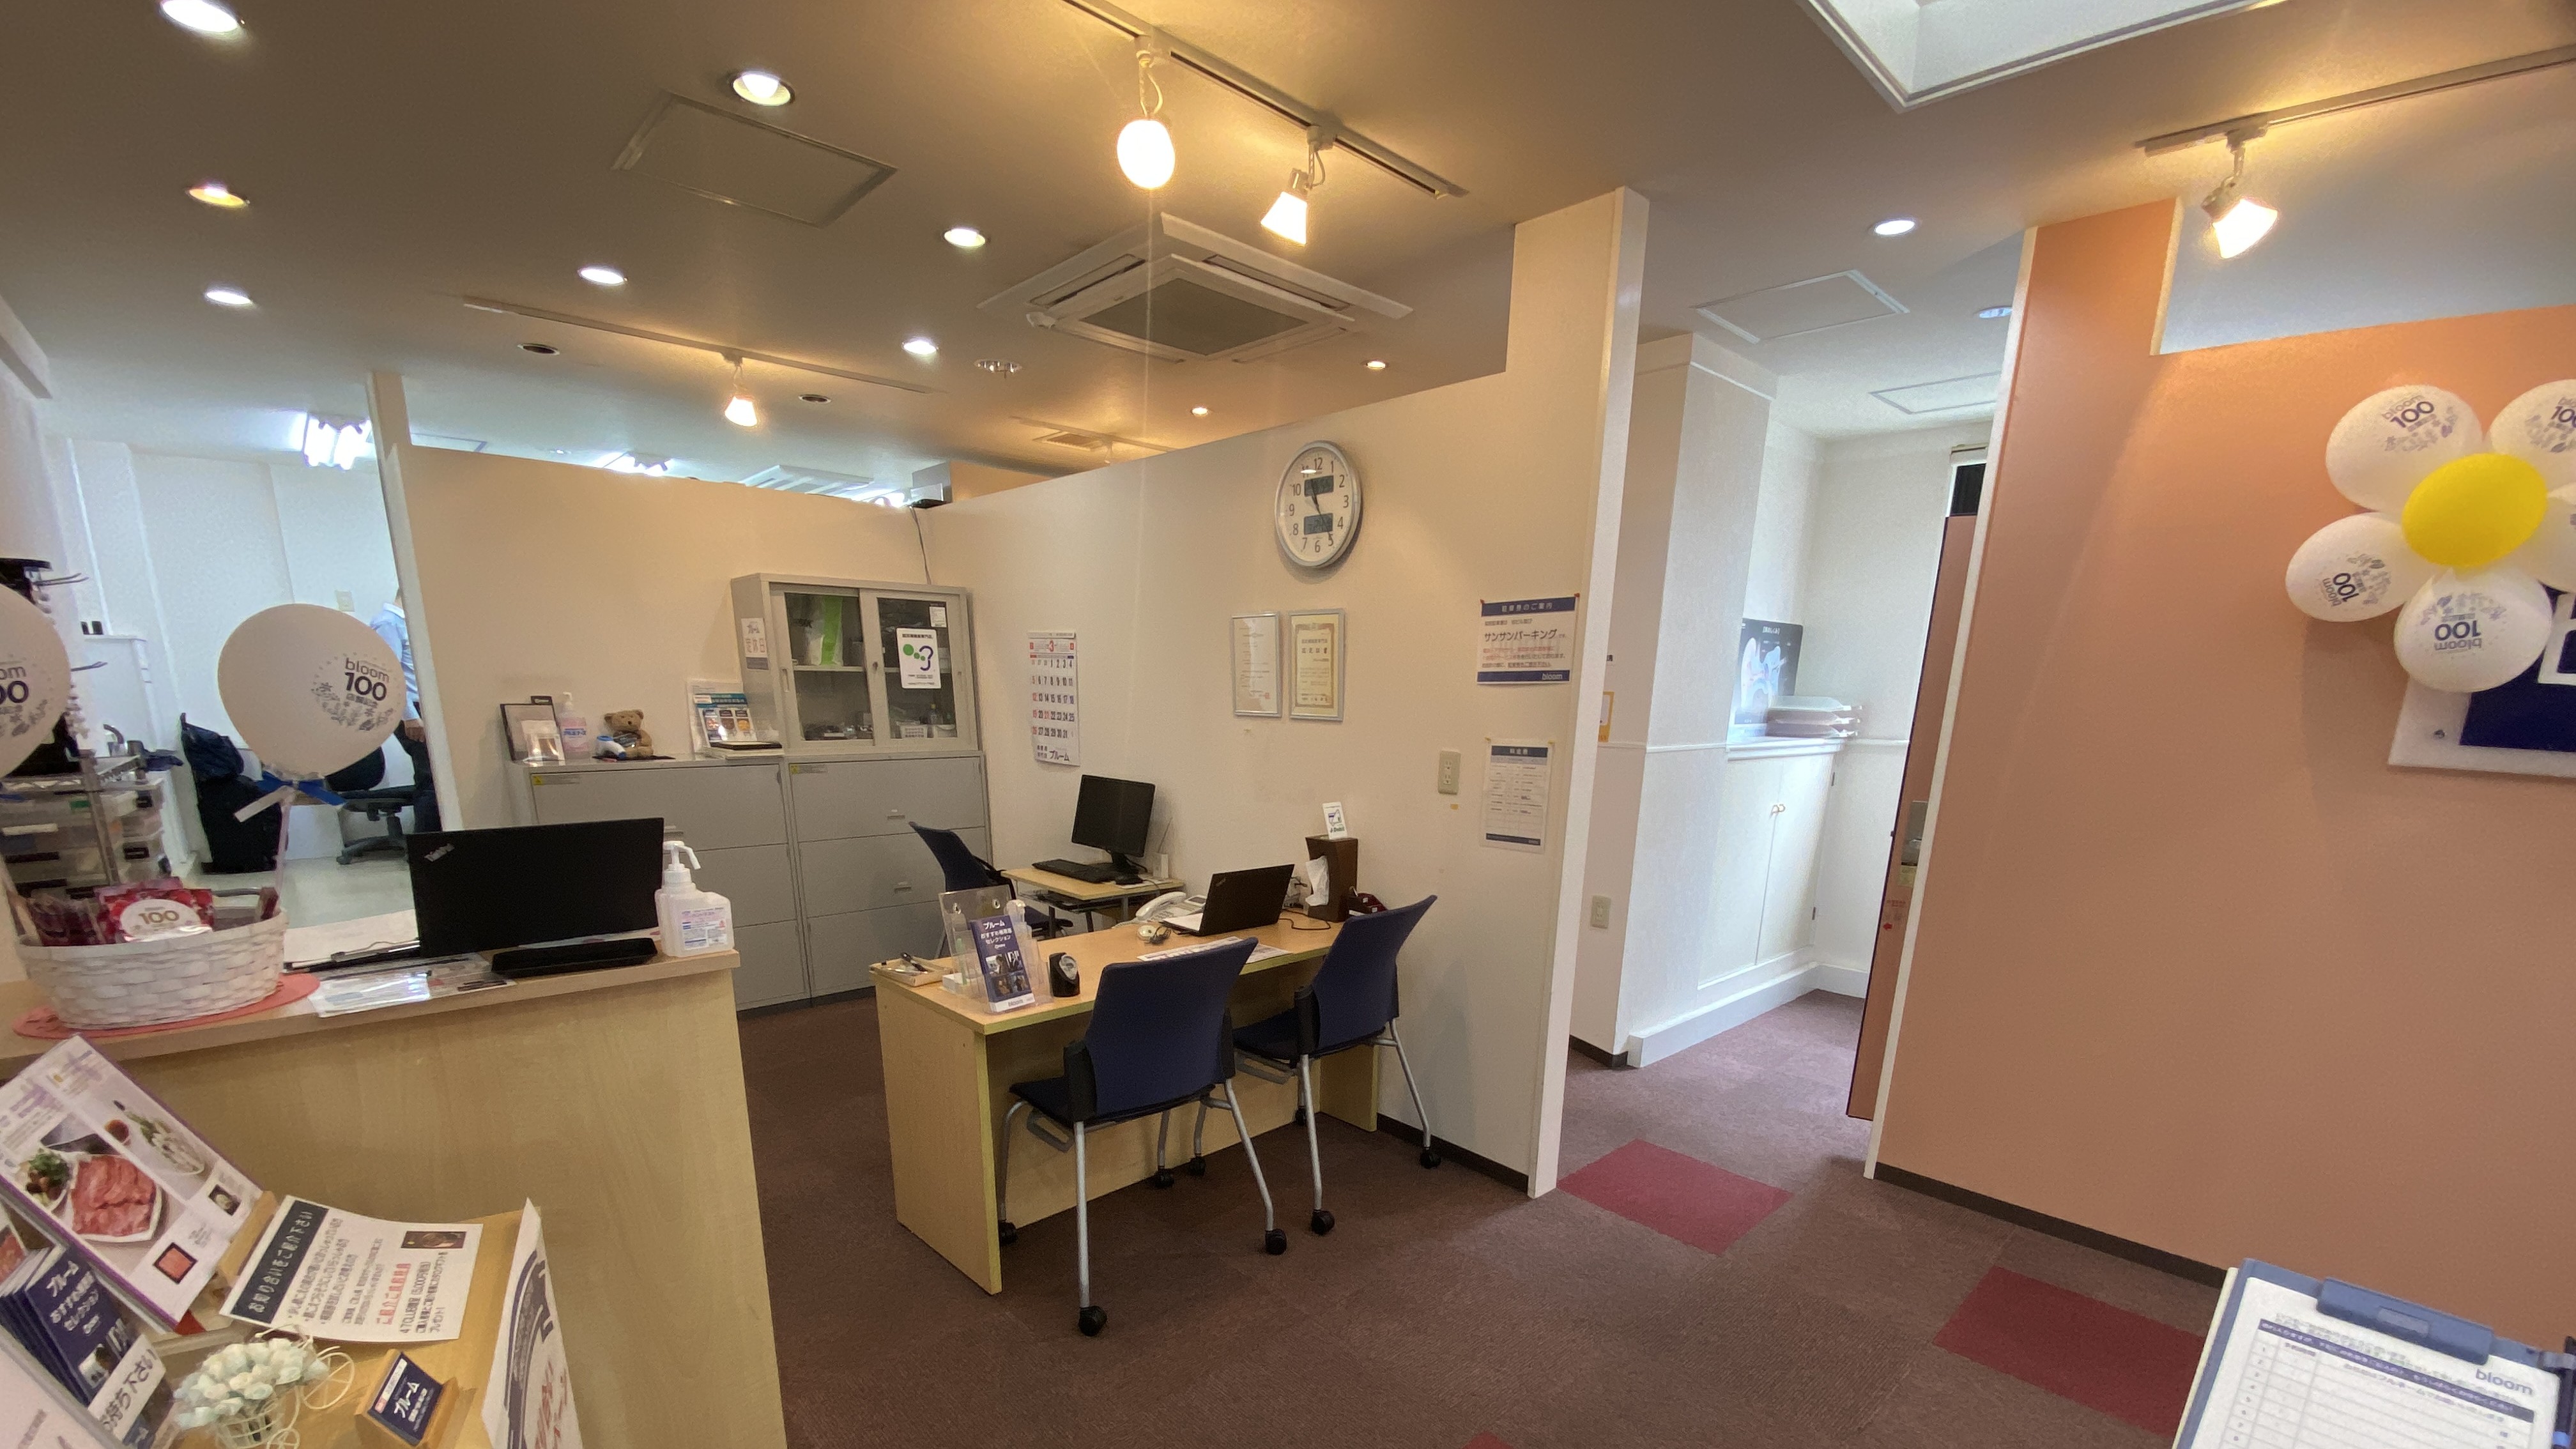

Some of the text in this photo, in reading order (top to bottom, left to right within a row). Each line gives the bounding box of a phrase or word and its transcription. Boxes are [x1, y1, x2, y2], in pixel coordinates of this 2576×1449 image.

[2390, 401, 2435, 428] 100
[1314, 457, 1322, 470] 12
[1331, 461, 1334, 473] 1
[1339, 475, 1345, 487] 2
[1292, 484, 1301, 496] 10
[1344, 495, 1349, 508] 3
[1289, 503, 1295, 516] 9
[1337, 516, 1344, 529] 4
[1292, 524, 1298, 535] 8
[1302, 537, 1308, 549] 7
[1328, 533, 1333, 546] 5
[1314, 540, 1321, 553] 6
[2333, 572, 2359, 602] 100
[2434, 620, 2481, 641] 100
[1050, 640, 1054, 652] 3
[2434, 638, 2482, 651] bloom
[345, 657, 390, 682] bloom
[1050, 659, 1053, 668] 1
[1057, 659, 1059, 668] 2
[1062, 659, 1066, 668] 3
[1069, 659, 1073, 668] 4
[345, 672, 387, 702] 100
[1032, 675, 1073, 686] 5 6 7 8 9 10 11
[1038, 693, 1043, 702] 13
[1045, 693, 1049, 703] 14
[1063, 712, 1068, 721] 24
[1049, 750, 1070, 762] ブルーム
[138, 910, 179, 924] 100
[983, 920, 1005, 930] ブルーム
[2476, 1368, 2533, 1395] bloom
[394, 1382, 420, 1418] ブルーム
